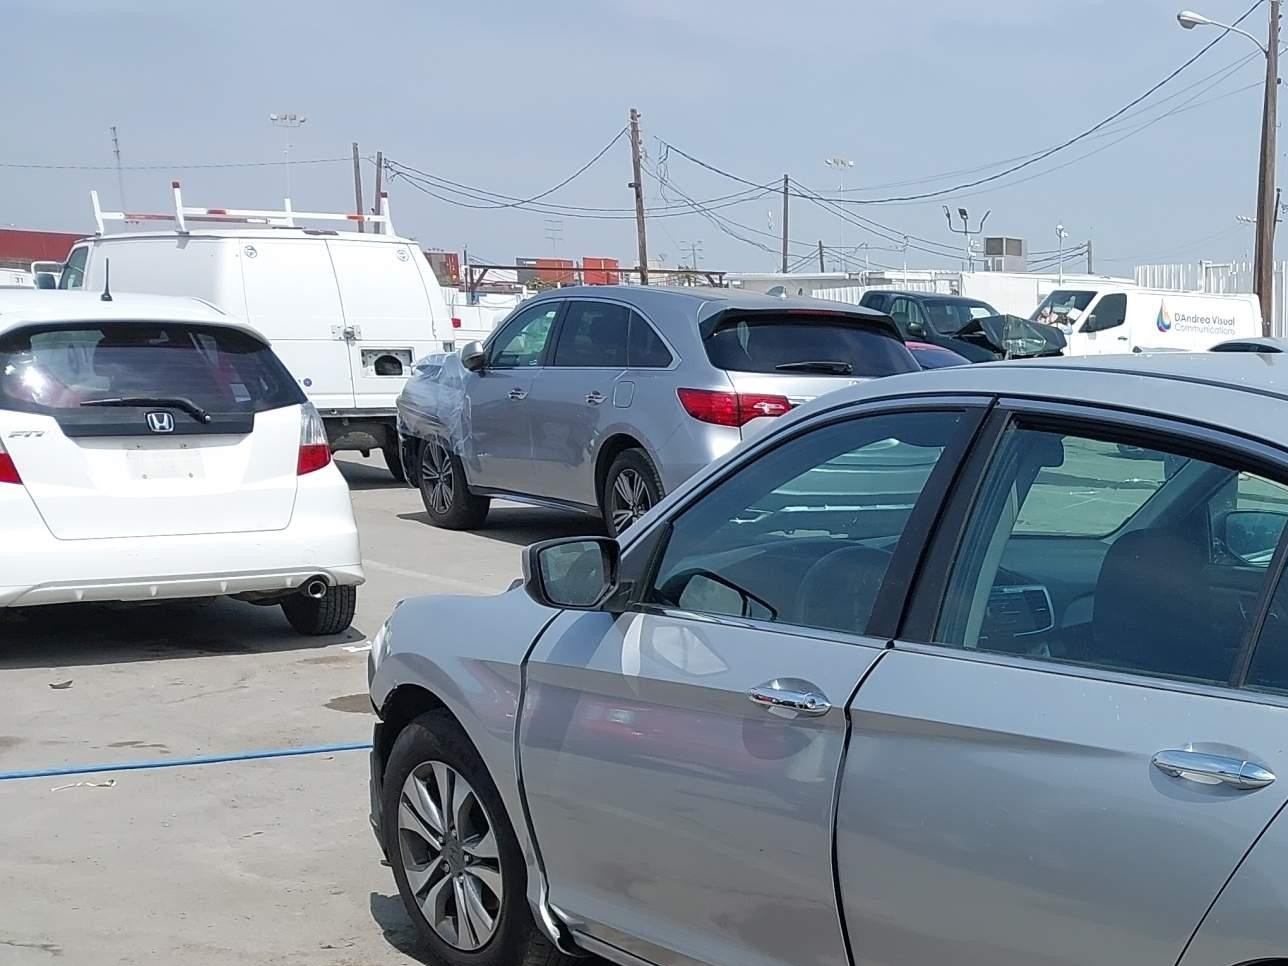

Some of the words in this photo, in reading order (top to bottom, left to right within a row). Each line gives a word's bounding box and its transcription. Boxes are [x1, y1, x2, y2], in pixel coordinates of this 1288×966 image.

[1174, 313, 1210, 324] D'Andrea
[1212, 315, 1235, 326] Visual
[1174, 323, 1236, 335] Communications
